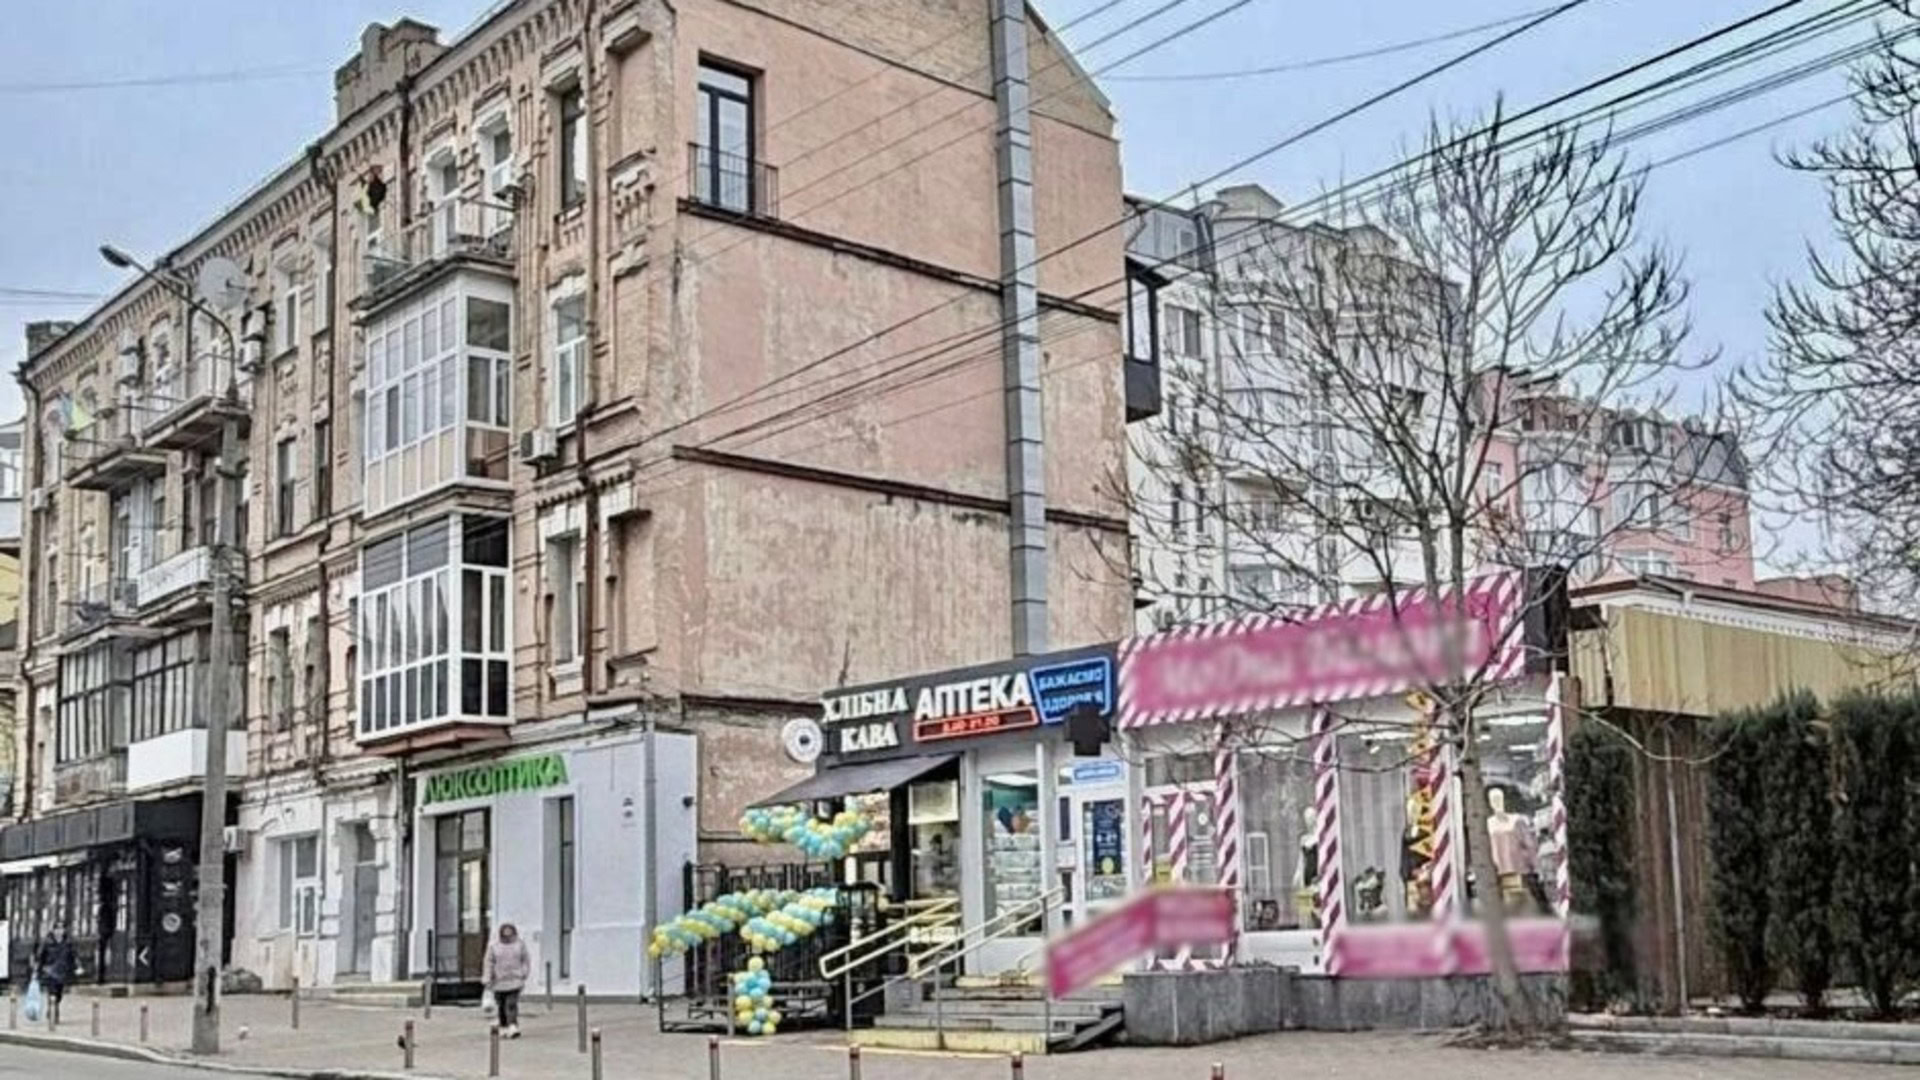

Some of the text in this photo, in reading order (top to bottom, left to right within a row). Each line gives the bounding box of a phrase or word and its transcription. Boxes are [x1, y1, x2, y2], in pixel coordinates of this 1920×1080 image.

[819, 687, 909, 723] ХЛІБНА
[915, 672, 1032, 721] АПТЕКА
[841, 722, 898, 752] КАВА
